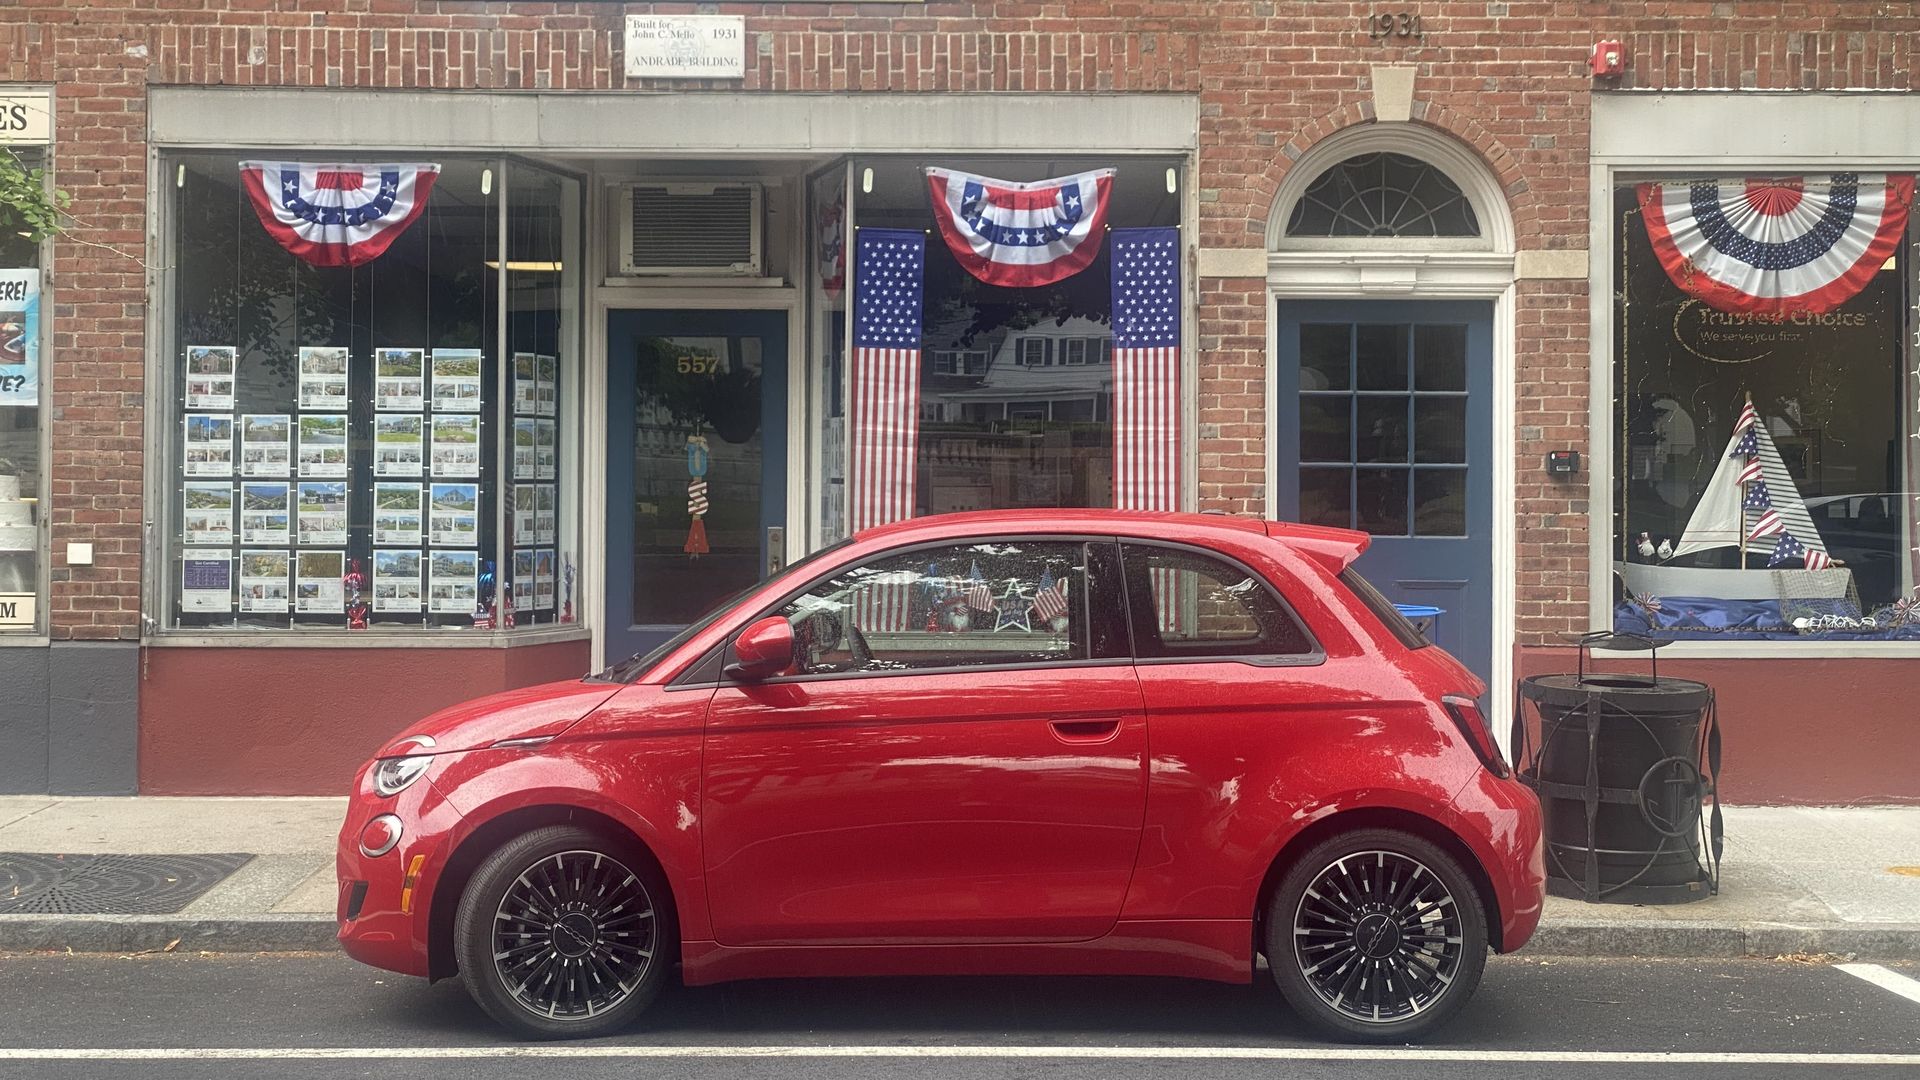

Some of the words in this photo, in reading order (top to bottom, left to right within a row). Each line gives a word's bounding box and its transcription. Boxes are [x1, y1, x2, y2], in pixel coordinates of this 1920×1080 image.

[633, 20, 656, 29] Built
[659, 20, 671, 29] for
[1369, 13, 1422, 38] 1931
[632, 30, 655, 39] John
[658, 30, 668, 39] C.
[671, 30, 695, 39] Mello
[713, 29, 737, 39] 1931
[633, 56, 683, 66] ANDRADE
[689, 56, 738, 66] BUILDING
[1698, 307, 1784, 326] Trusted
[1700, 331, 1719, 341] We
[1755, 334, 1775, 343] you
[677, 356, 720, 374] 557
[0, 375, 25, 392] E?
[0, 602, 17, 618] M
